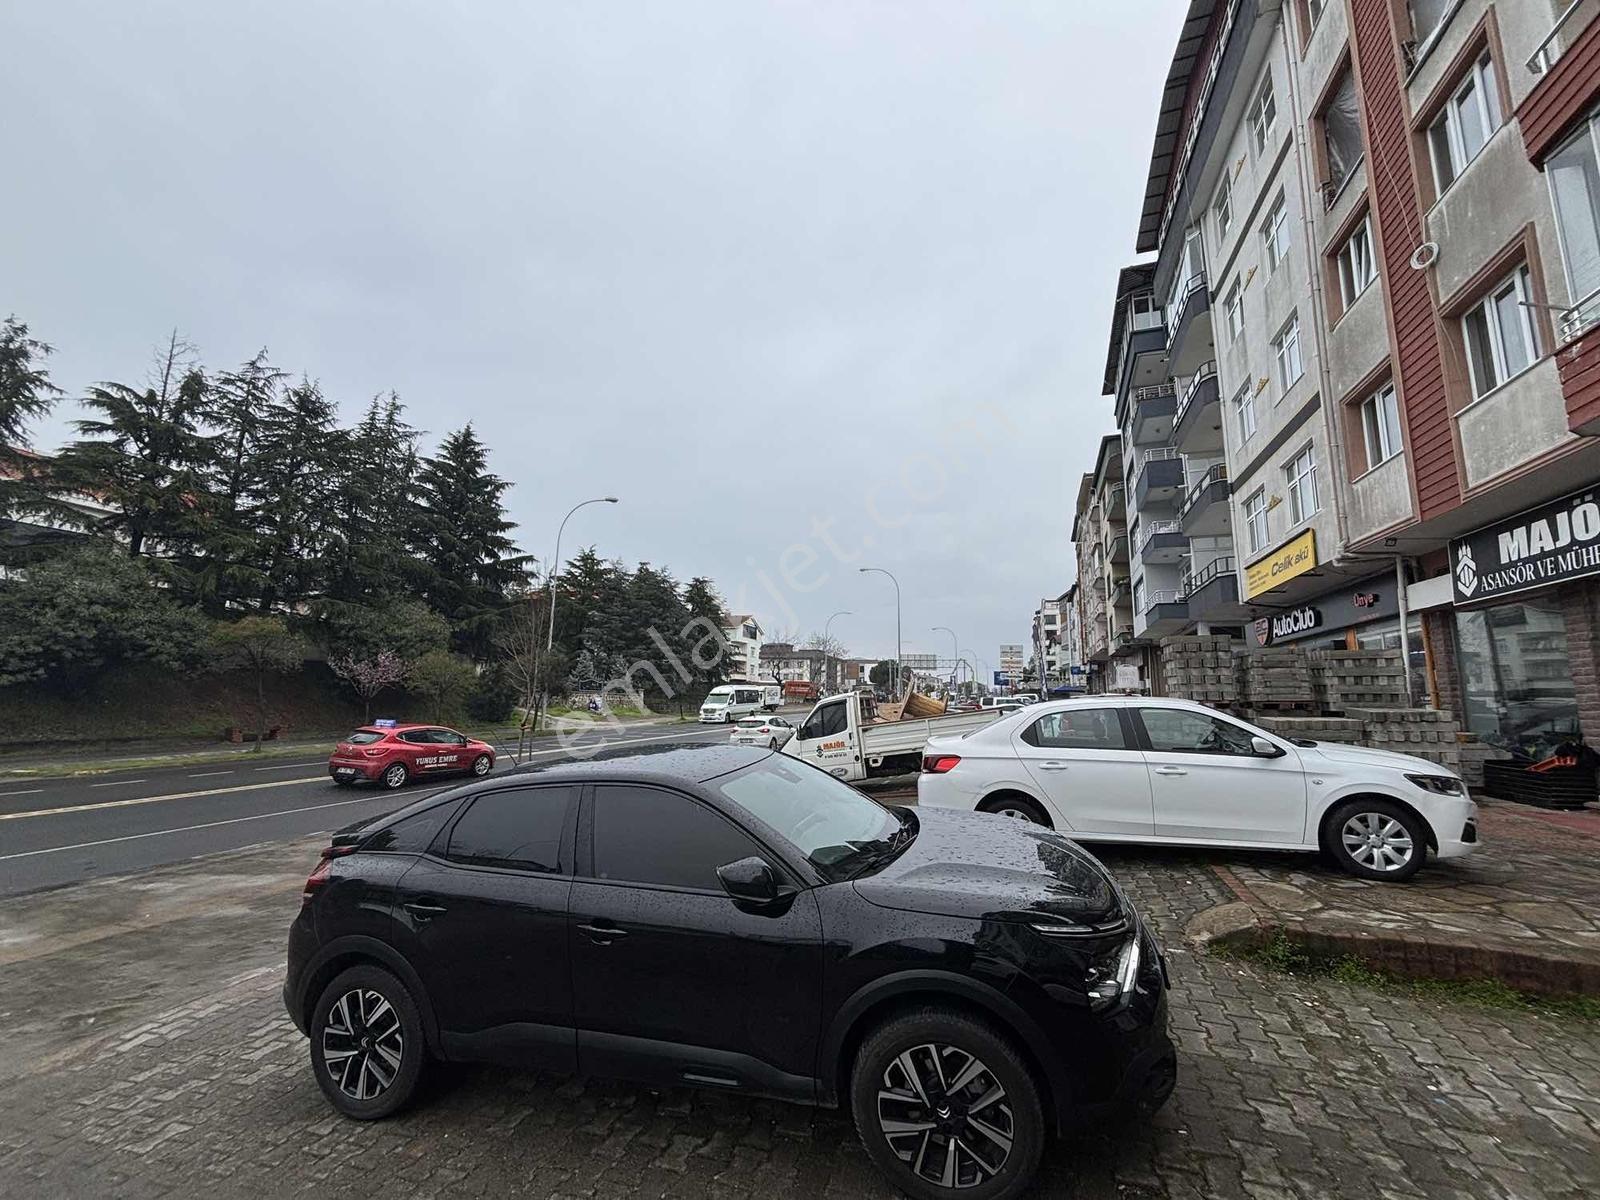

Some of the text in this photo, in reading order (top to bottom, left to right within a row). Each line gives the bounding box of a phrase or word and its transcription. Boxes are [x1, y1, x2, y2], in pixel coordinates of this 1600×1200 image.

[1481, 562, 1536, 592] ASANSÖR
[1537, 557, 1556, 577] VE
[1272, 606, 1315, 638] AutoClub
[415, 755, 458, 765] YUNUS EMRE
